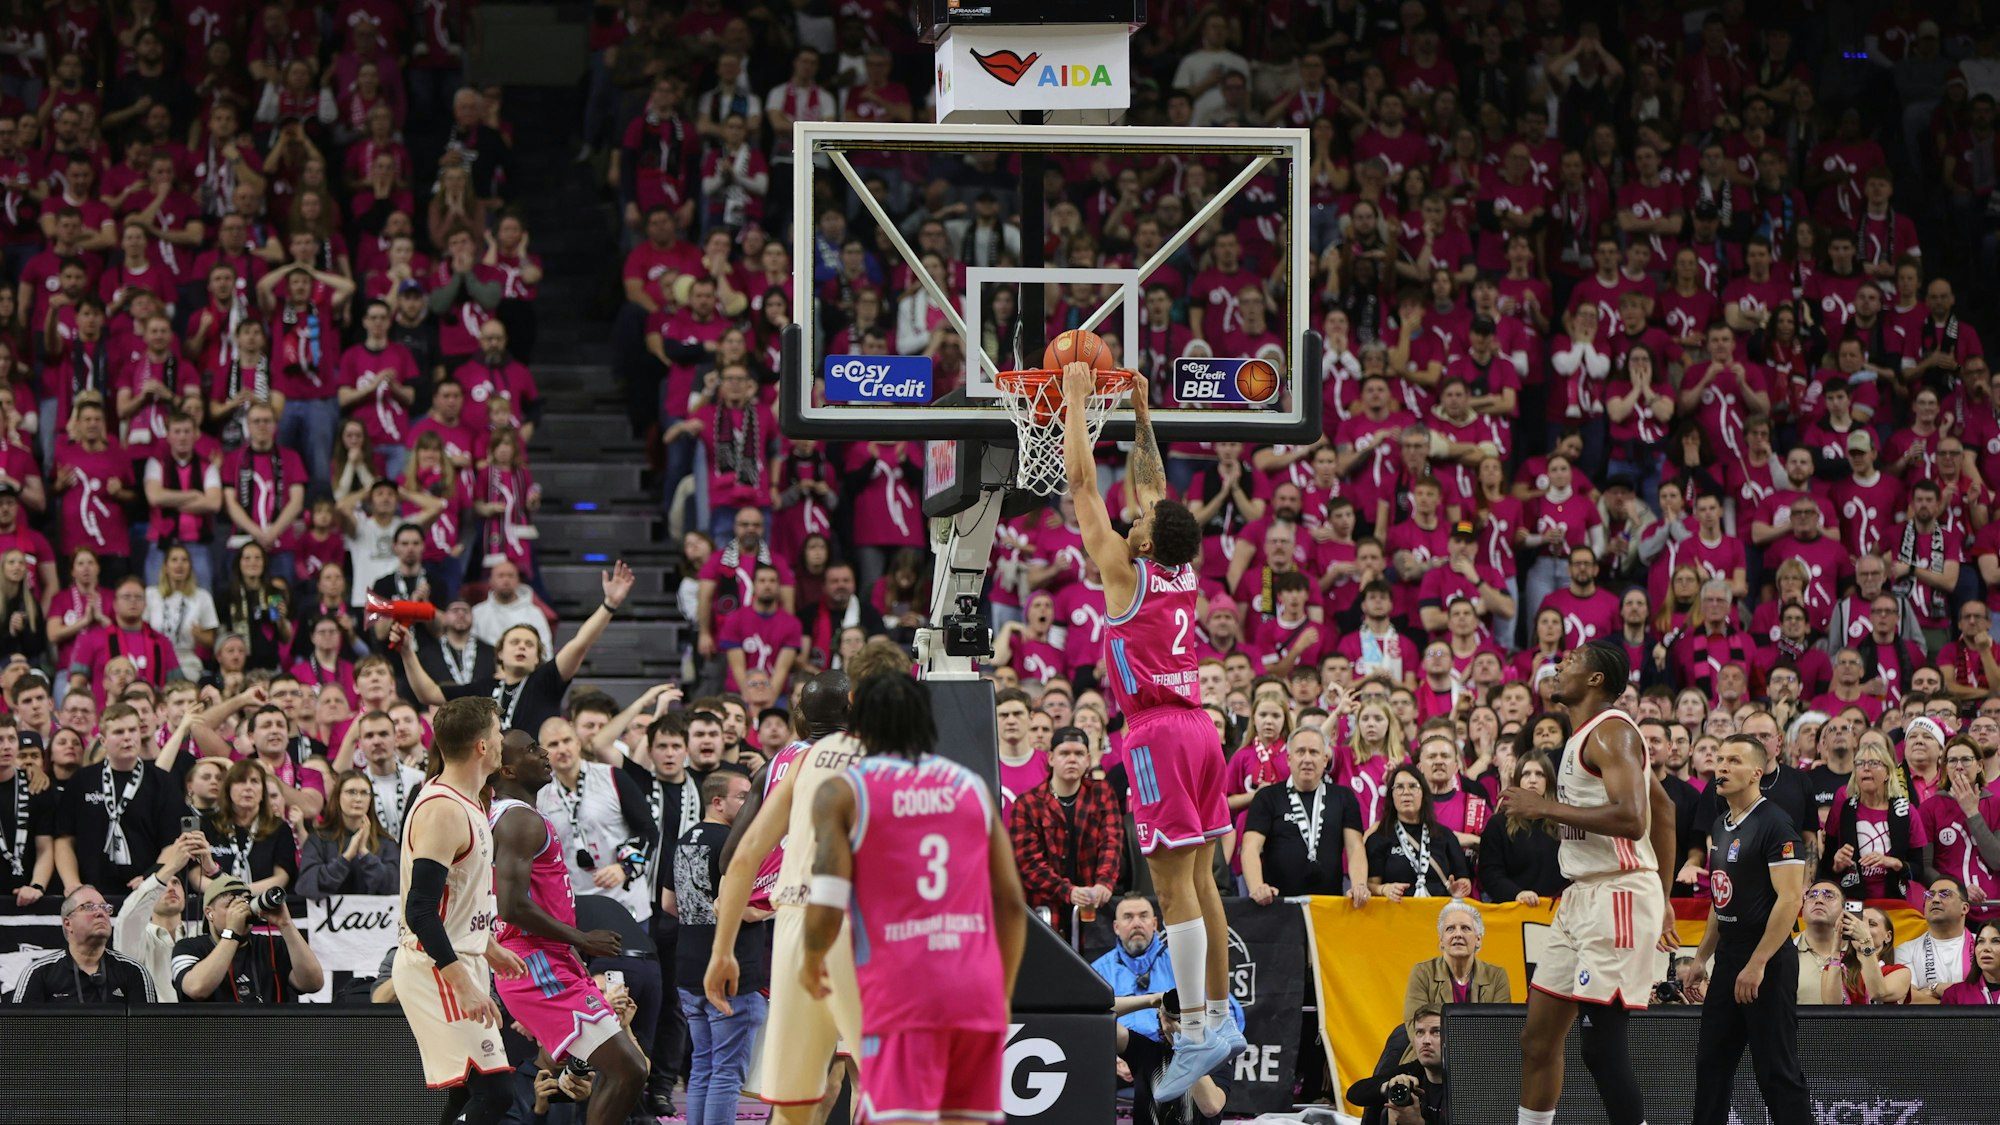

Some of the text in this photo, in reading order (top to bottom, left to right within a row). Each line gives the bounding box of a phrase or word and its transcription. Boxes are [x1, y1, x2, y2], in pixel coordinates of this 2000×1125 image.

[1037, 65, 1112, 87] AIDA
[1194, 370, 1226, 380] Credit
[858, 379, 926, 398] Credit
[1181, 380, 1226, 398] BBL
[1171, 608, 1189, 655] 2
[814, 750, 862, 769] GIFF
[772, 762, 790, 783] JO
[892, 787, 957, 818] COOKS
[916, 833, 950, 901] 3
[317, 896, 394, 933] Xavi
[1230, 1043, 1281, 1082] RE
